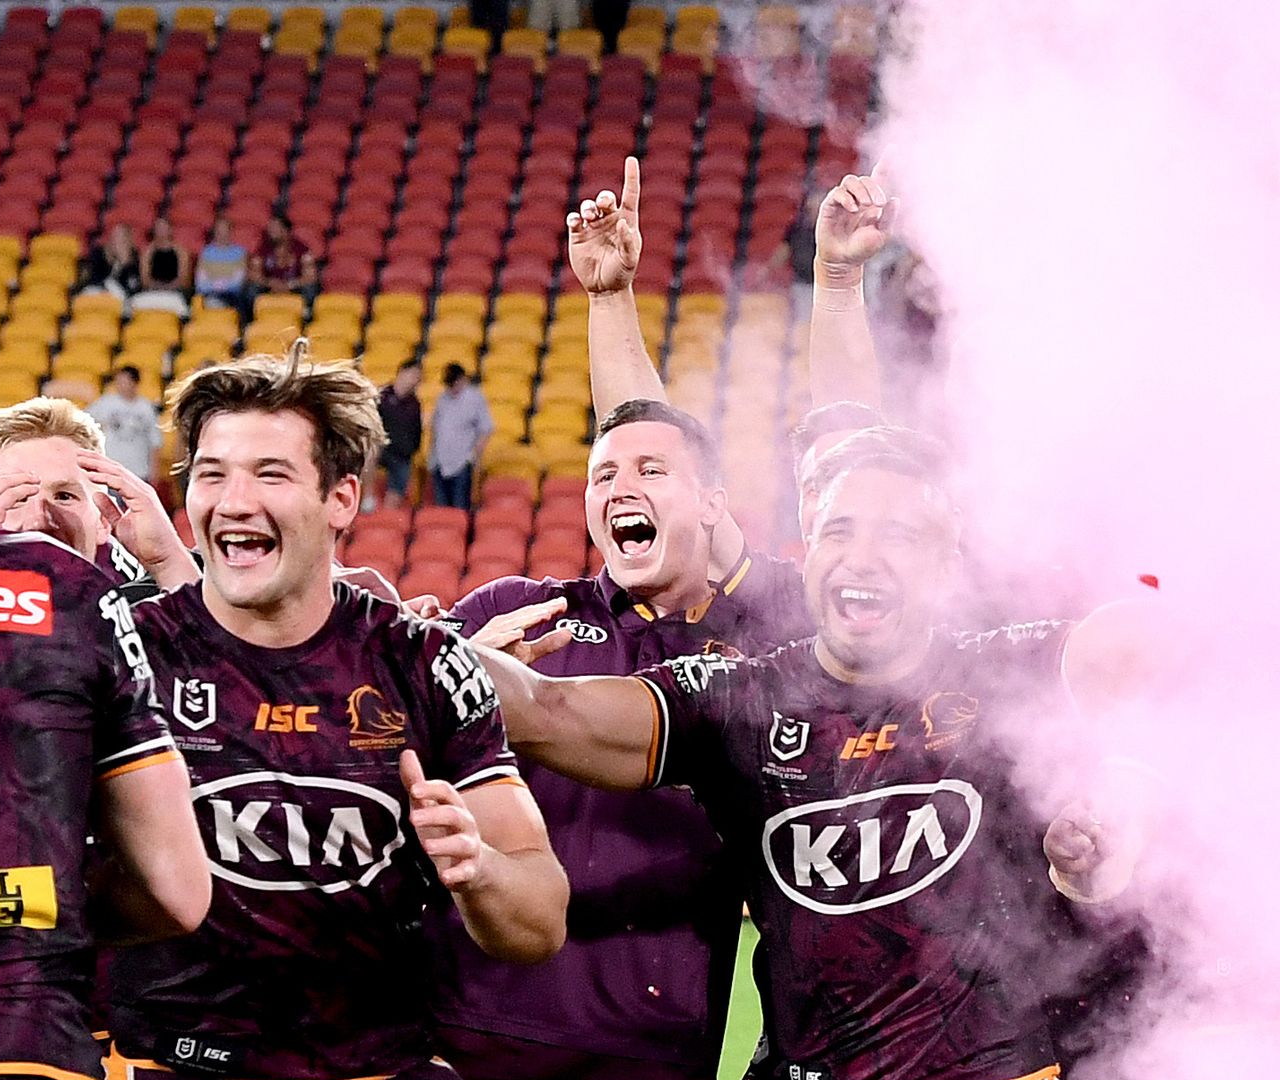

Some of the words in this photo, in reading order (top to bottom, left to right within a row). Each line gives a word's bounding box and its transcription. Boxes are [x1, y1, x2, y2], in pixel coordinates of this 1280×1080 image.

[568, 623, 599, 642] KIA
[254, 703, 320, 733] ISC
[840, 723, 899, 760] ISC
[207, 799, 374, 867] KIA
[790, 803, 949, 888] KIA
[203, 1048, 231, 1062] ISC
